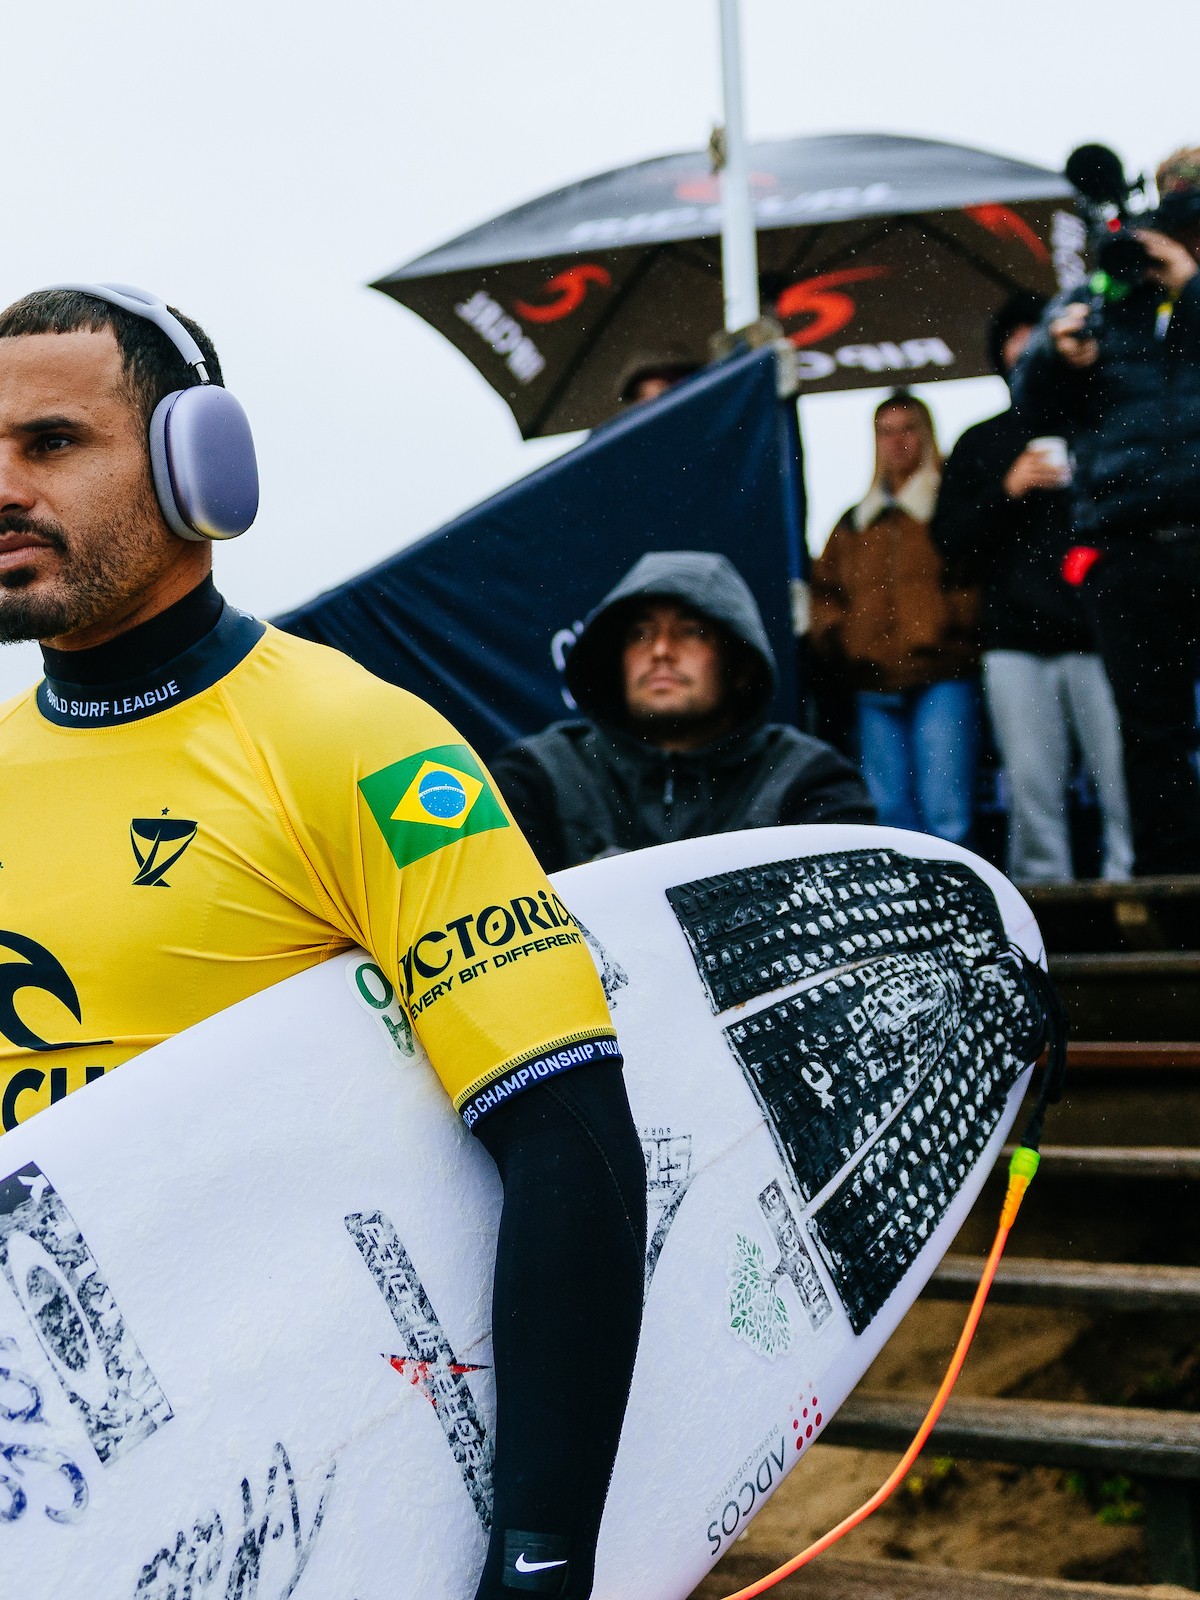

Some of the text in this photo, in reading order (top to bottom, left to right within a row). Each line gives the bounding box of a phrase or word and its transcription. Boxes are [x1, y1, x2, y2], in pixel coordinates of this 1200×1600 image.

[70, 701, 109, 717] SURF
[114, 680, 180, 715] LEAGUE
[459, 960, 488, 984] BIT
[493, 932, 582, 968] DIFFERENT
[475, 1044, 595, 1113] CHAMPIONSHIP
[707, 1436, 785, 1556] ADCOS
